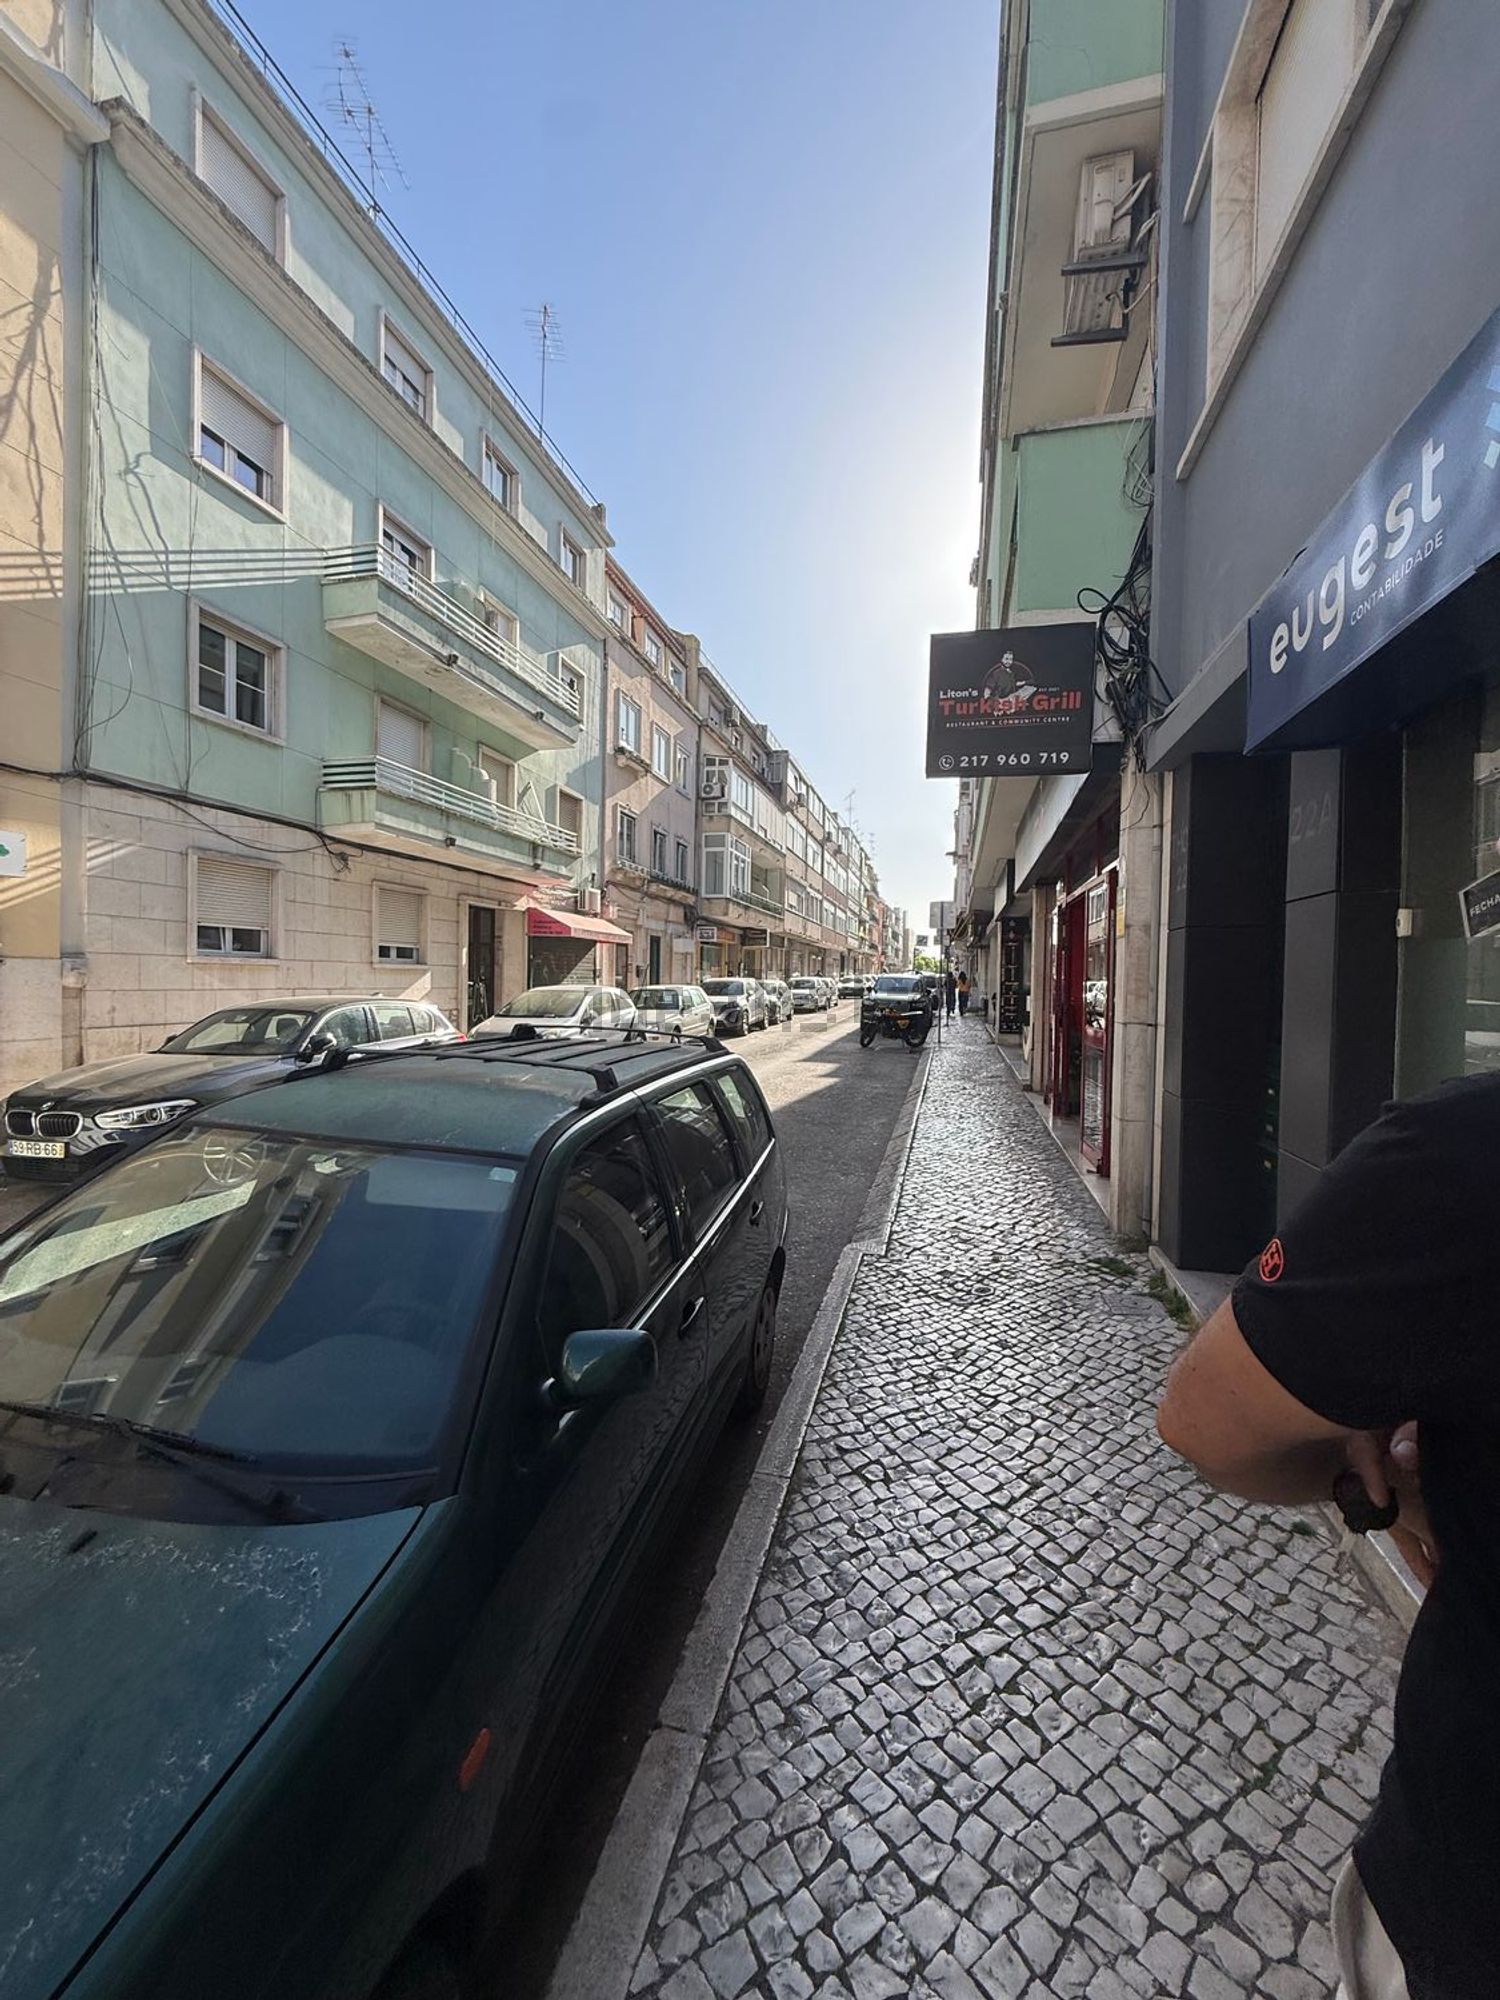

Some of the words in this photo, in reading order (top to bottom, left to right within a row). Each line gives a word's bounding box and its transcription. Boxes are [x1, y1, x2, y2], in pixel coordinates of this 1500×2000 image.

[1269, 437, 1446, 674] eugest
[1350, 530, 1444, 627] CONTABILIDADE
[939, 688, 979, 699] Liton's
[939, 695, 1028, 716] Turkish
[1032, 691, 1082, 711] Grill
[946, 720, 989, 728] RESTAURANT
[959, 755, 989, 768] 217
[997, 753, 1031, 765] 960
[1039, 752, 1070, 764] 719
